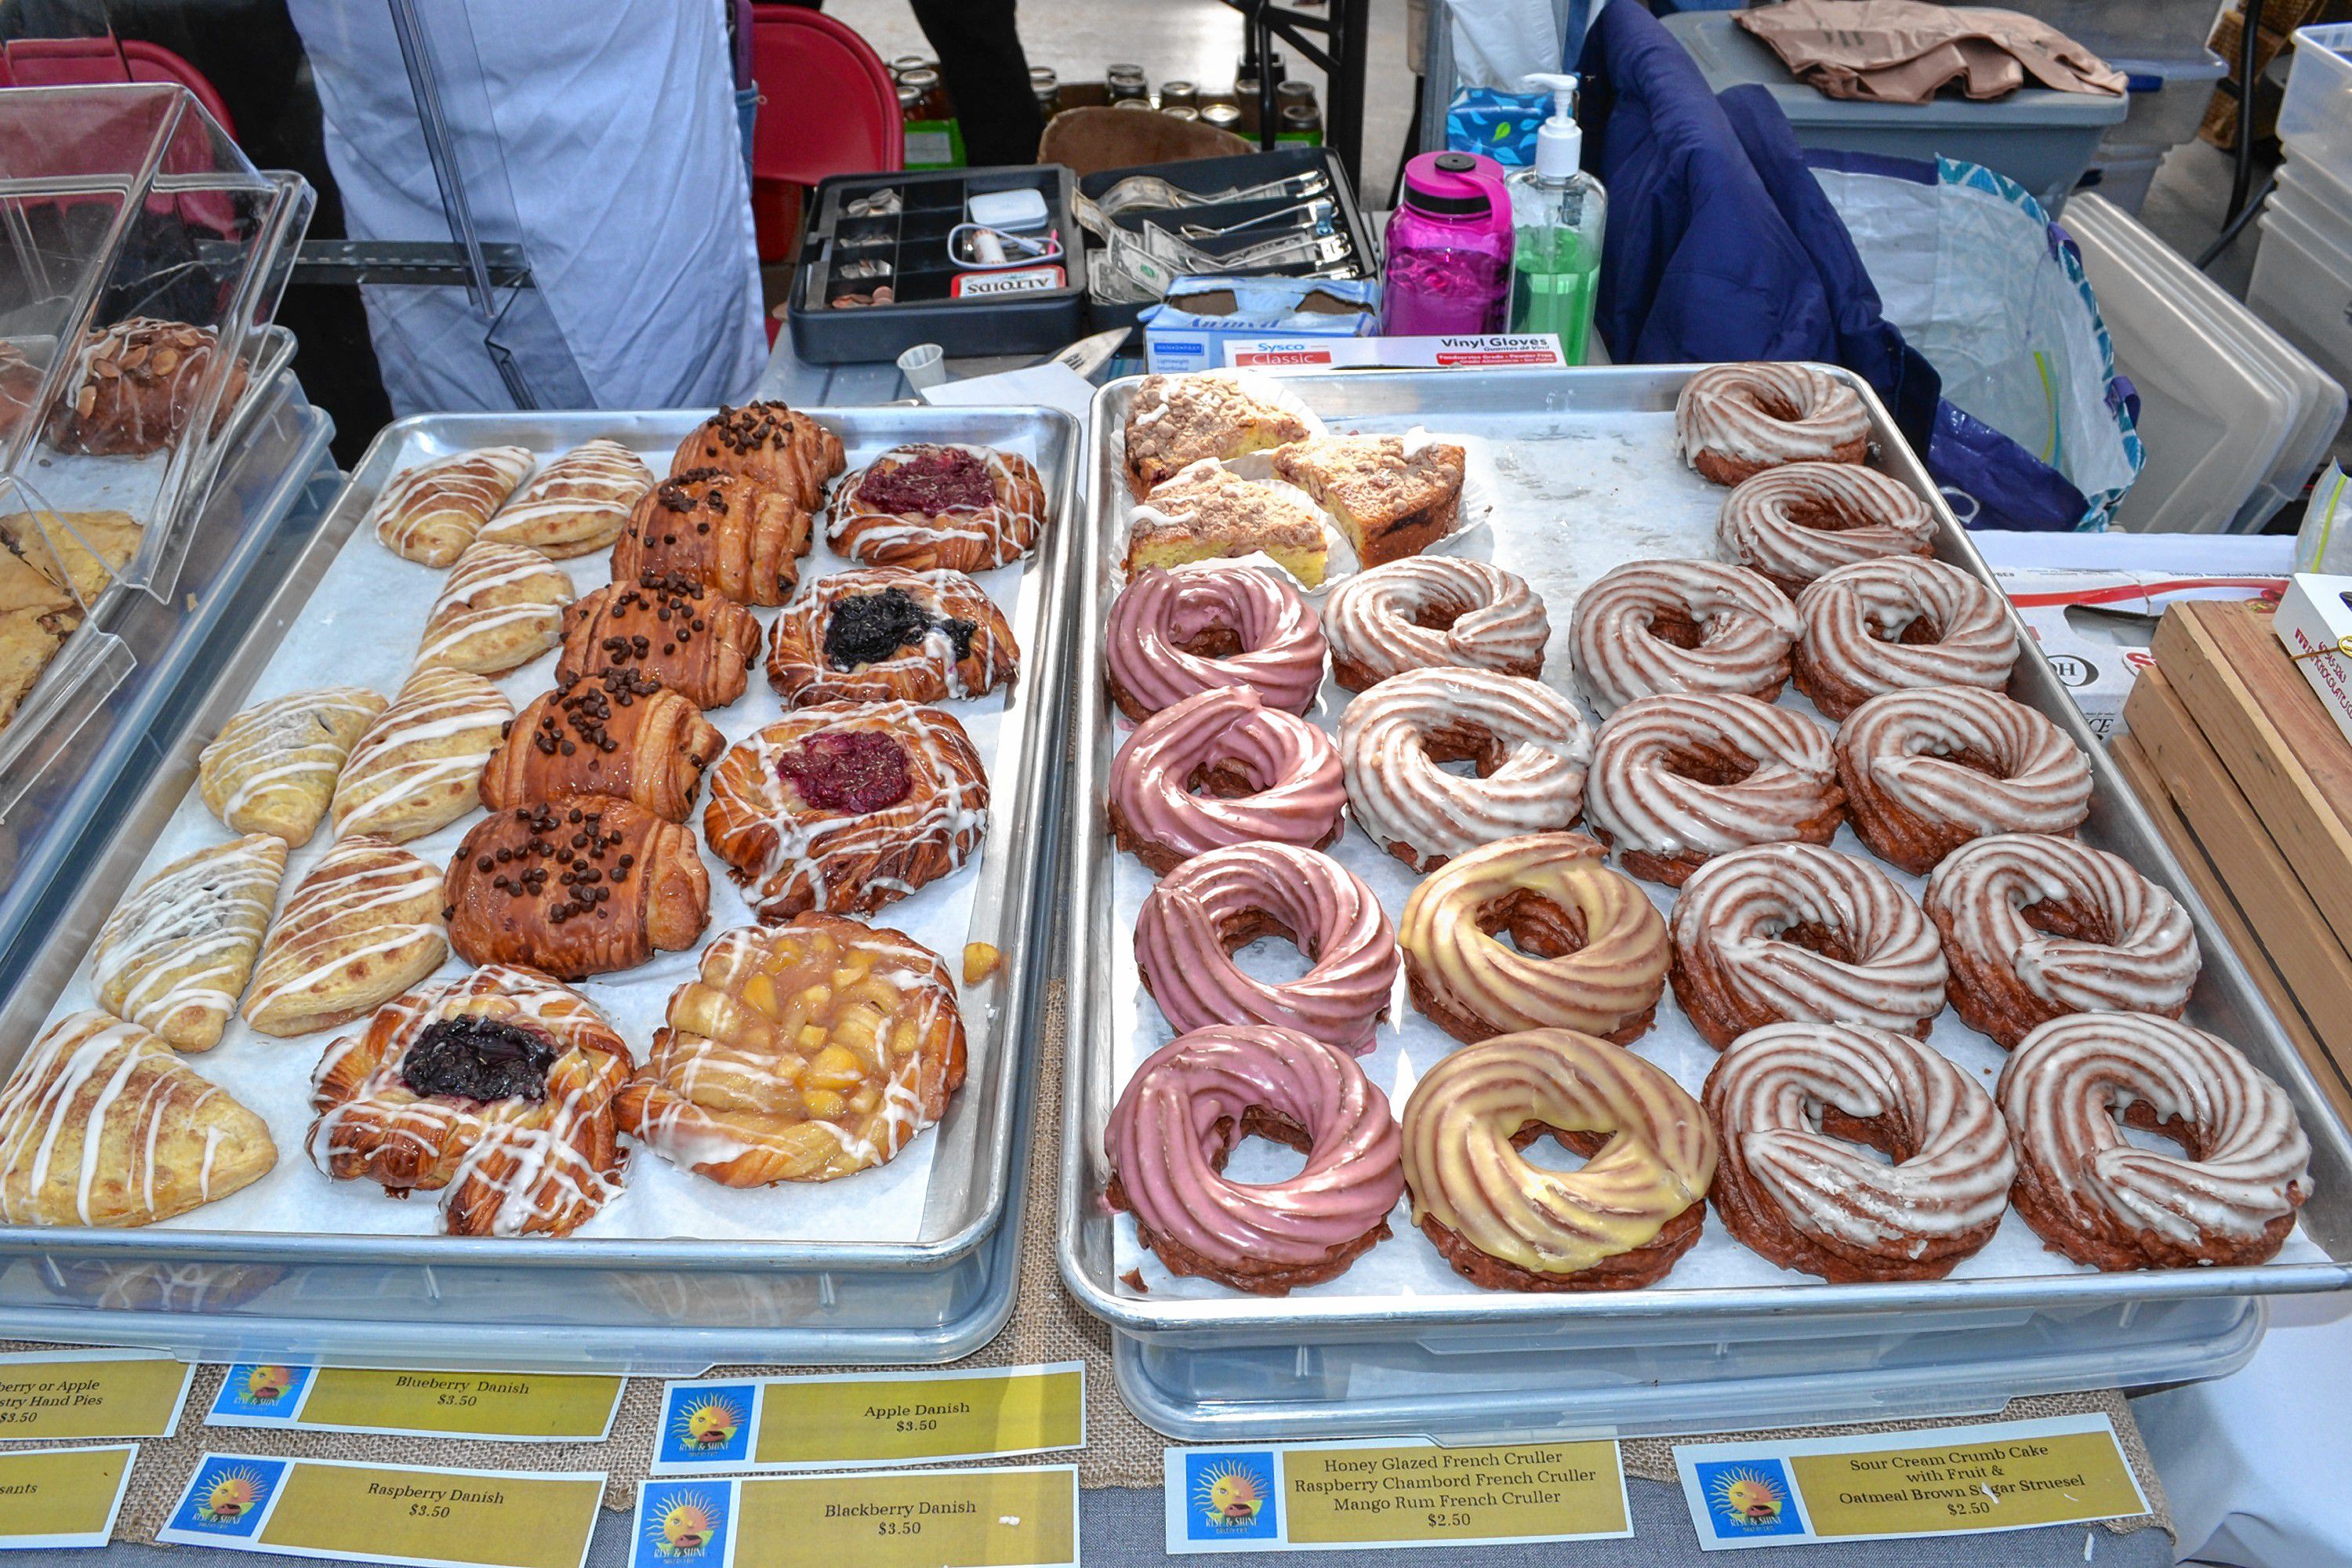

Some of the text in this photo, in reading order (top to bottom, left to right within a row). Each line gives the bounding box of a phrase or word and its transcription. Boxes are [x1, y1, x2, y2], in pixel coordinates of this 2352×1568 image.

[967, 278, 1051, 294] ALTOIDS
[1258, 343, 1305, 353] Sysco
[1441, 337, 1548, 349] Vinyl Gloves
[1251, 353, 1315, 365] Classic
[39, 1383, 55, 1392] or
[56, 1380, 100, 1393] Apple
[395, 1376, 529, 1394] Blueberry Danish
[29, 1395, 71, 1406] Hand
[74, 1395, 103, 1406] Pies
[437, 1394, 477, 1406] $3.50
[0, 1412, 38, 1423] $3.50
[863, 1403, 970, 1419] Apple Danish
[896, 1420, 937, 1432] $3.50
[1324, 1451, 1563, 1474] Honey Glazed French Cruller
[1850, 1445, 2049, 1472] Sour Cream Crumb Cake
[1294, 1469, 1596, 1494] Raspberry Chambord French Cruller
[1906, 1465, 2005, 1483] with Fruit &
[368, 1483, 504, 1504] Raspberry Danish
[1839, 1490, 1908, 1504] Oatmeal
[1909, 1487, 1967, 1501] Brown
[2020, 1474, 2086, 1491] Struesel
[1334, 1490, 1561, 1513] Mango Rum French Cruller
[1947, 1501, 1990, 1515] $2.50
[408, 1504, 450, 1518] $3.50
[825, 1501, 977, 1518] Blackberry Danish
[1428, 1513, 1471, 1528] $2.50
[878, 1521, 921, 1536] $3.50
